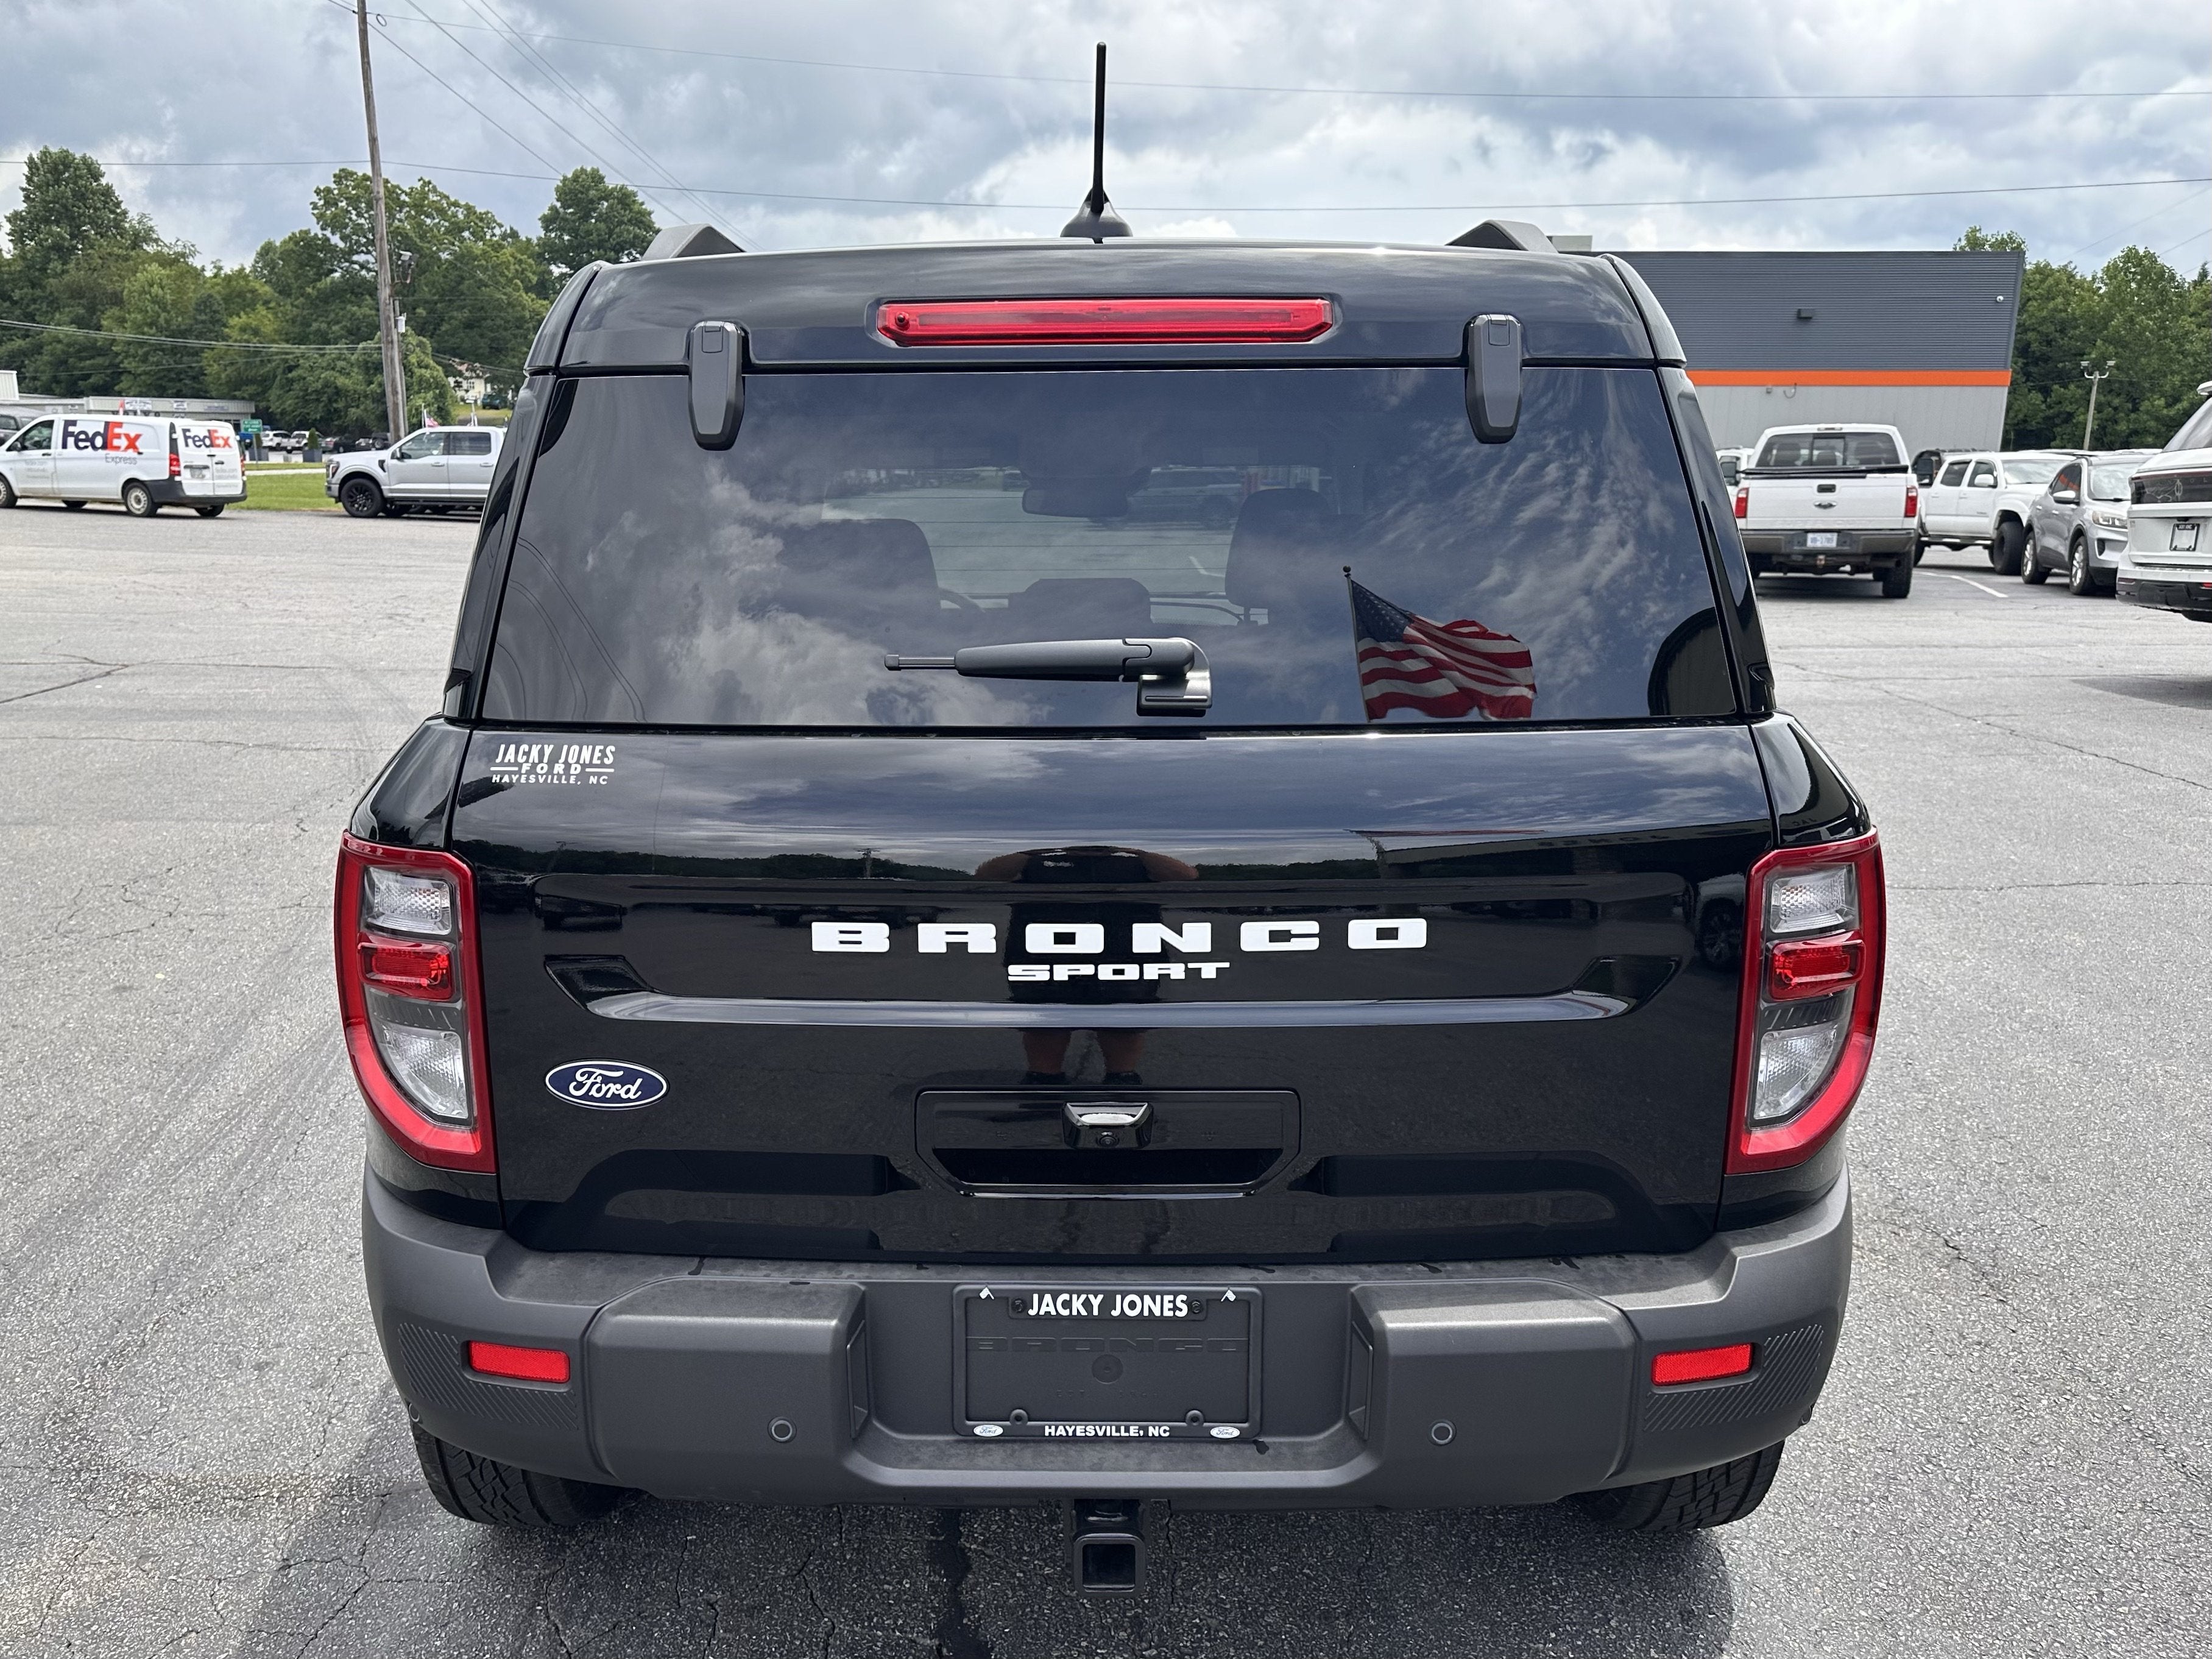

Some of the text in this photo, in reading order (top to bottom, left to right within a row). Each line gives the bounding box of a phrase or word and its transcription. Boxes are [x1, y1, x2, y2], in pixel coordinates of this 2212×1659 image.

[62, 419, 143, 453] FedEx
[182, 428, 232, 448] FedEx
[105, 453, 137, 465] Express
[495, 744, 615, 765] JACKY JONES
[521, 763, 581, 774] FORD
[492, 774, 608, 785] HAYESVILLE, NC
[811, 918, 1427, 954] BRONCO
[1008, 962, 1230, 982] SPORT
[568, 1067, 643, 1100] Ford
[1028, 1293, 1189, 1317] JACKY JONES
[966, 1337, 1248, 1353] BRONCO
[1044, 1425, 1170, 1437] HAYESVILLE, NC
